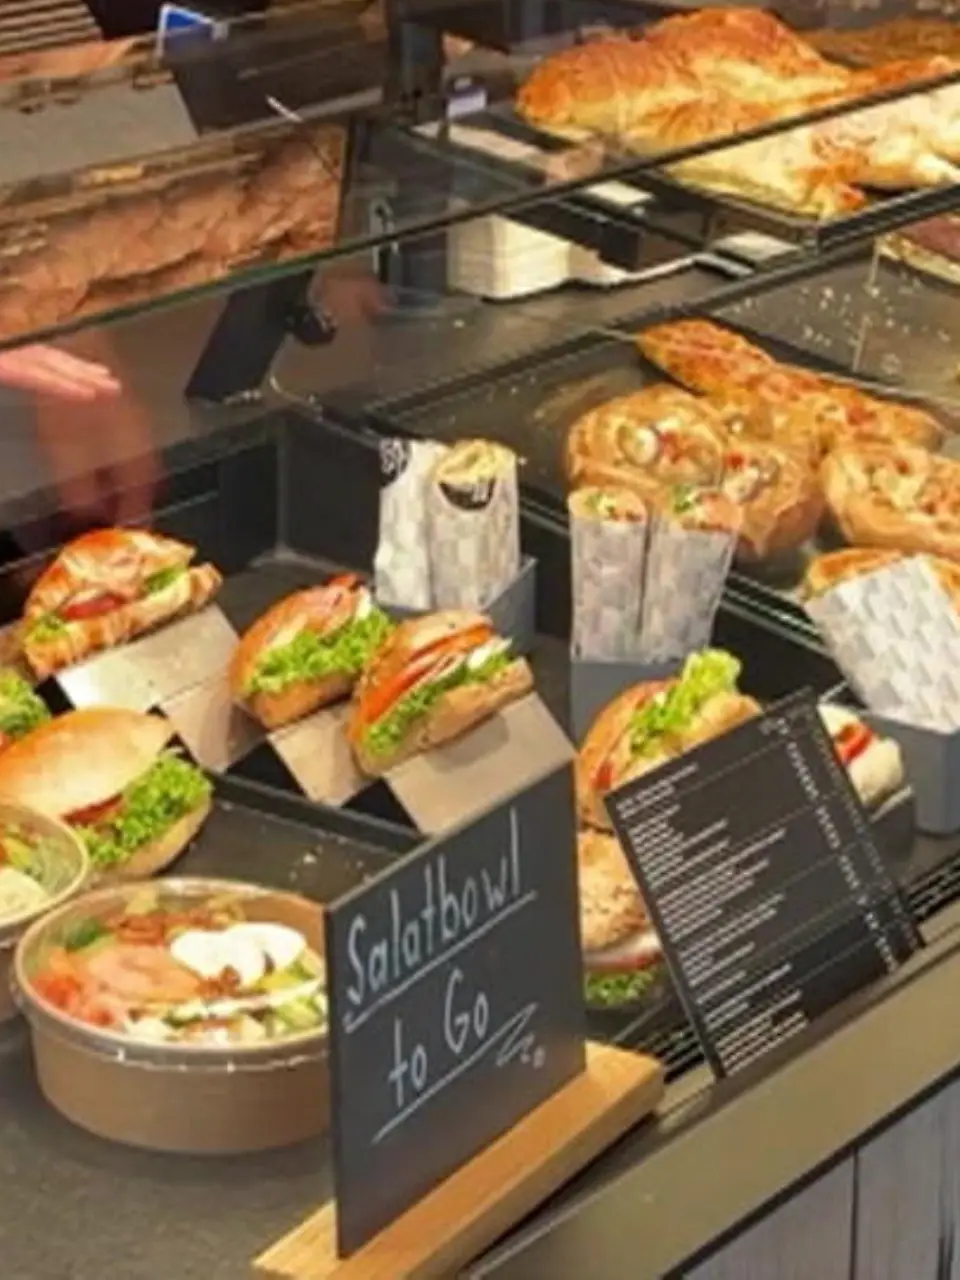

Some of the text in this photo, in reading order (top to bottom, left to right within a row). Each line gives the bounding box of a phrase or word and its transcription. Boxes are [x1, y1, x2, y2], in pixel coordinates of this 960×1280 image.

[347, 806, 520, 1005] Salatbowl
[388, 967, 490, 1109] to Go
